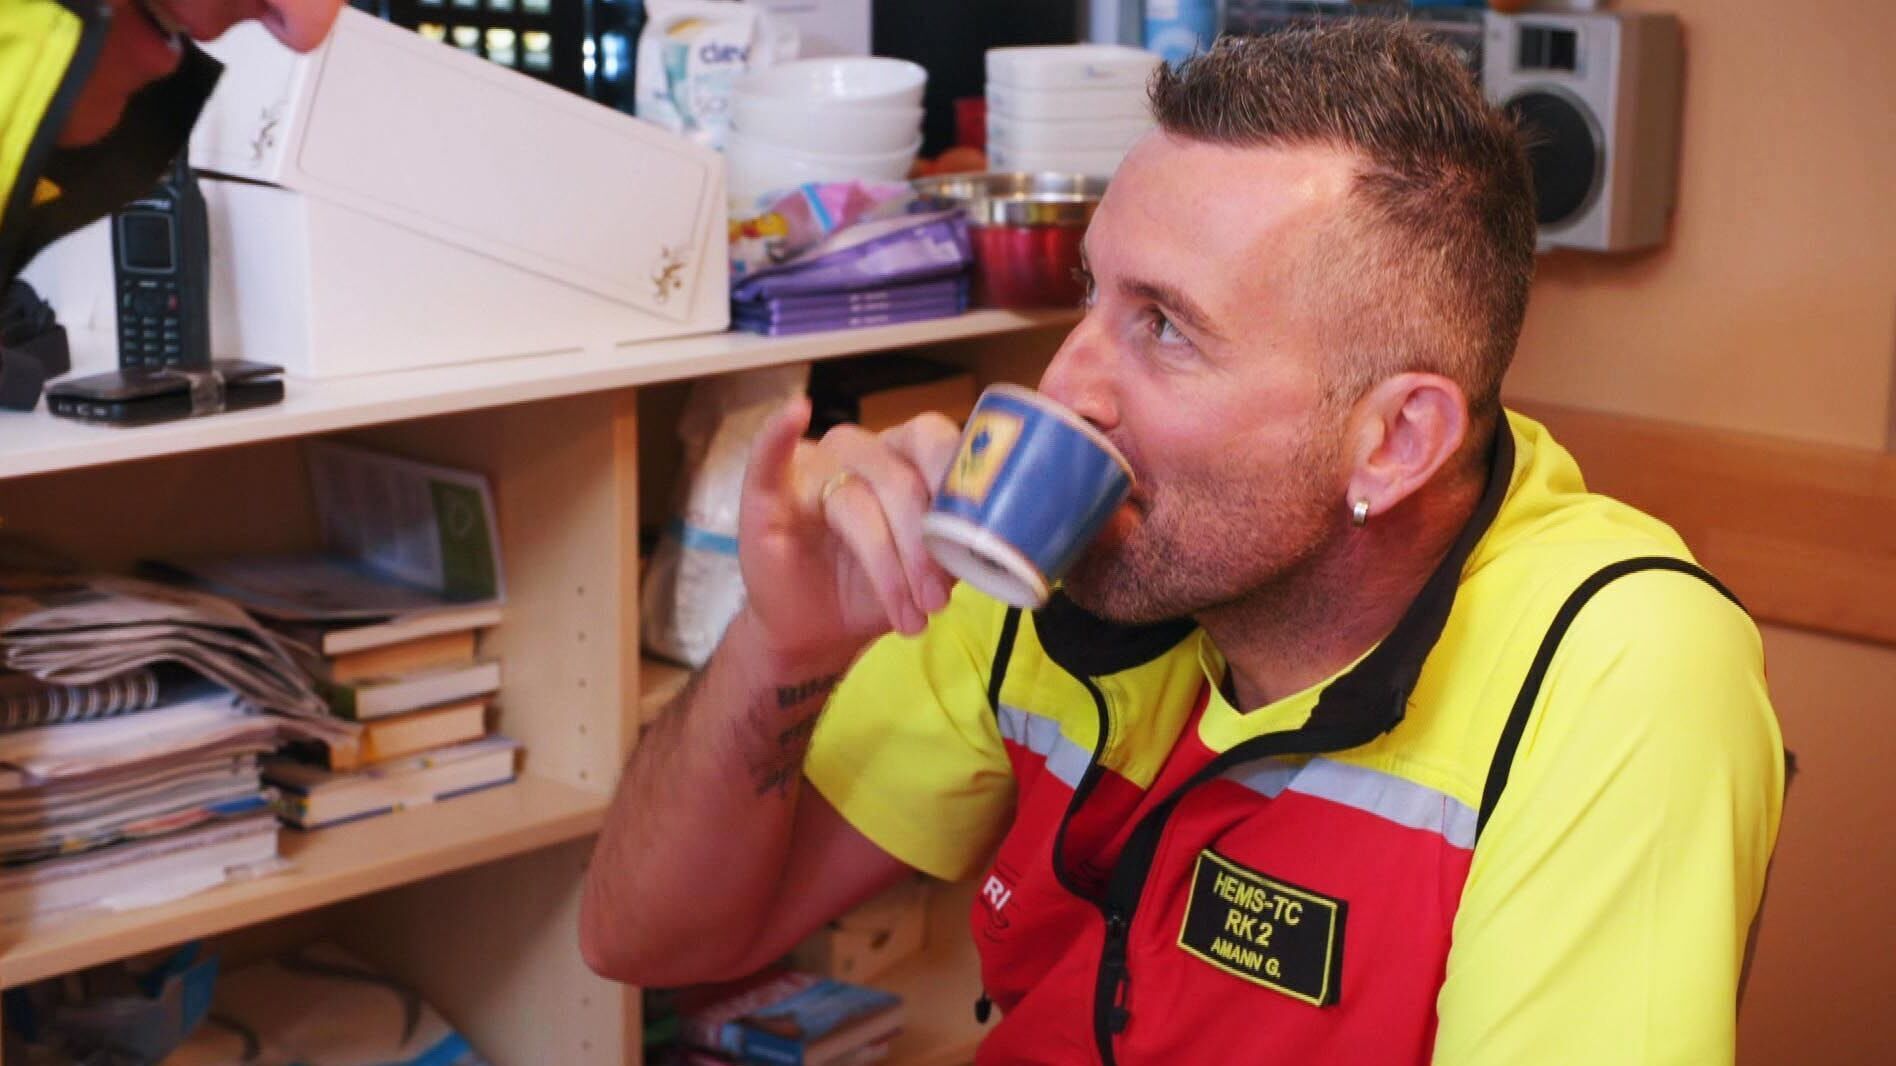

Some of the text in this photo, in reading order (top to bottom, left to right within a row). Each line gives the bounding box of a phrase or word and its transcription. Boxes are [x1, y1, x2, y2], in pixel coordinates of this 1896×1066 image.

[1213, 872, 1303, 925] HEMS-TC
[1224, 909, 1273, 946] RK 2
[1210, 936, 1281, 978] AMANN G.
